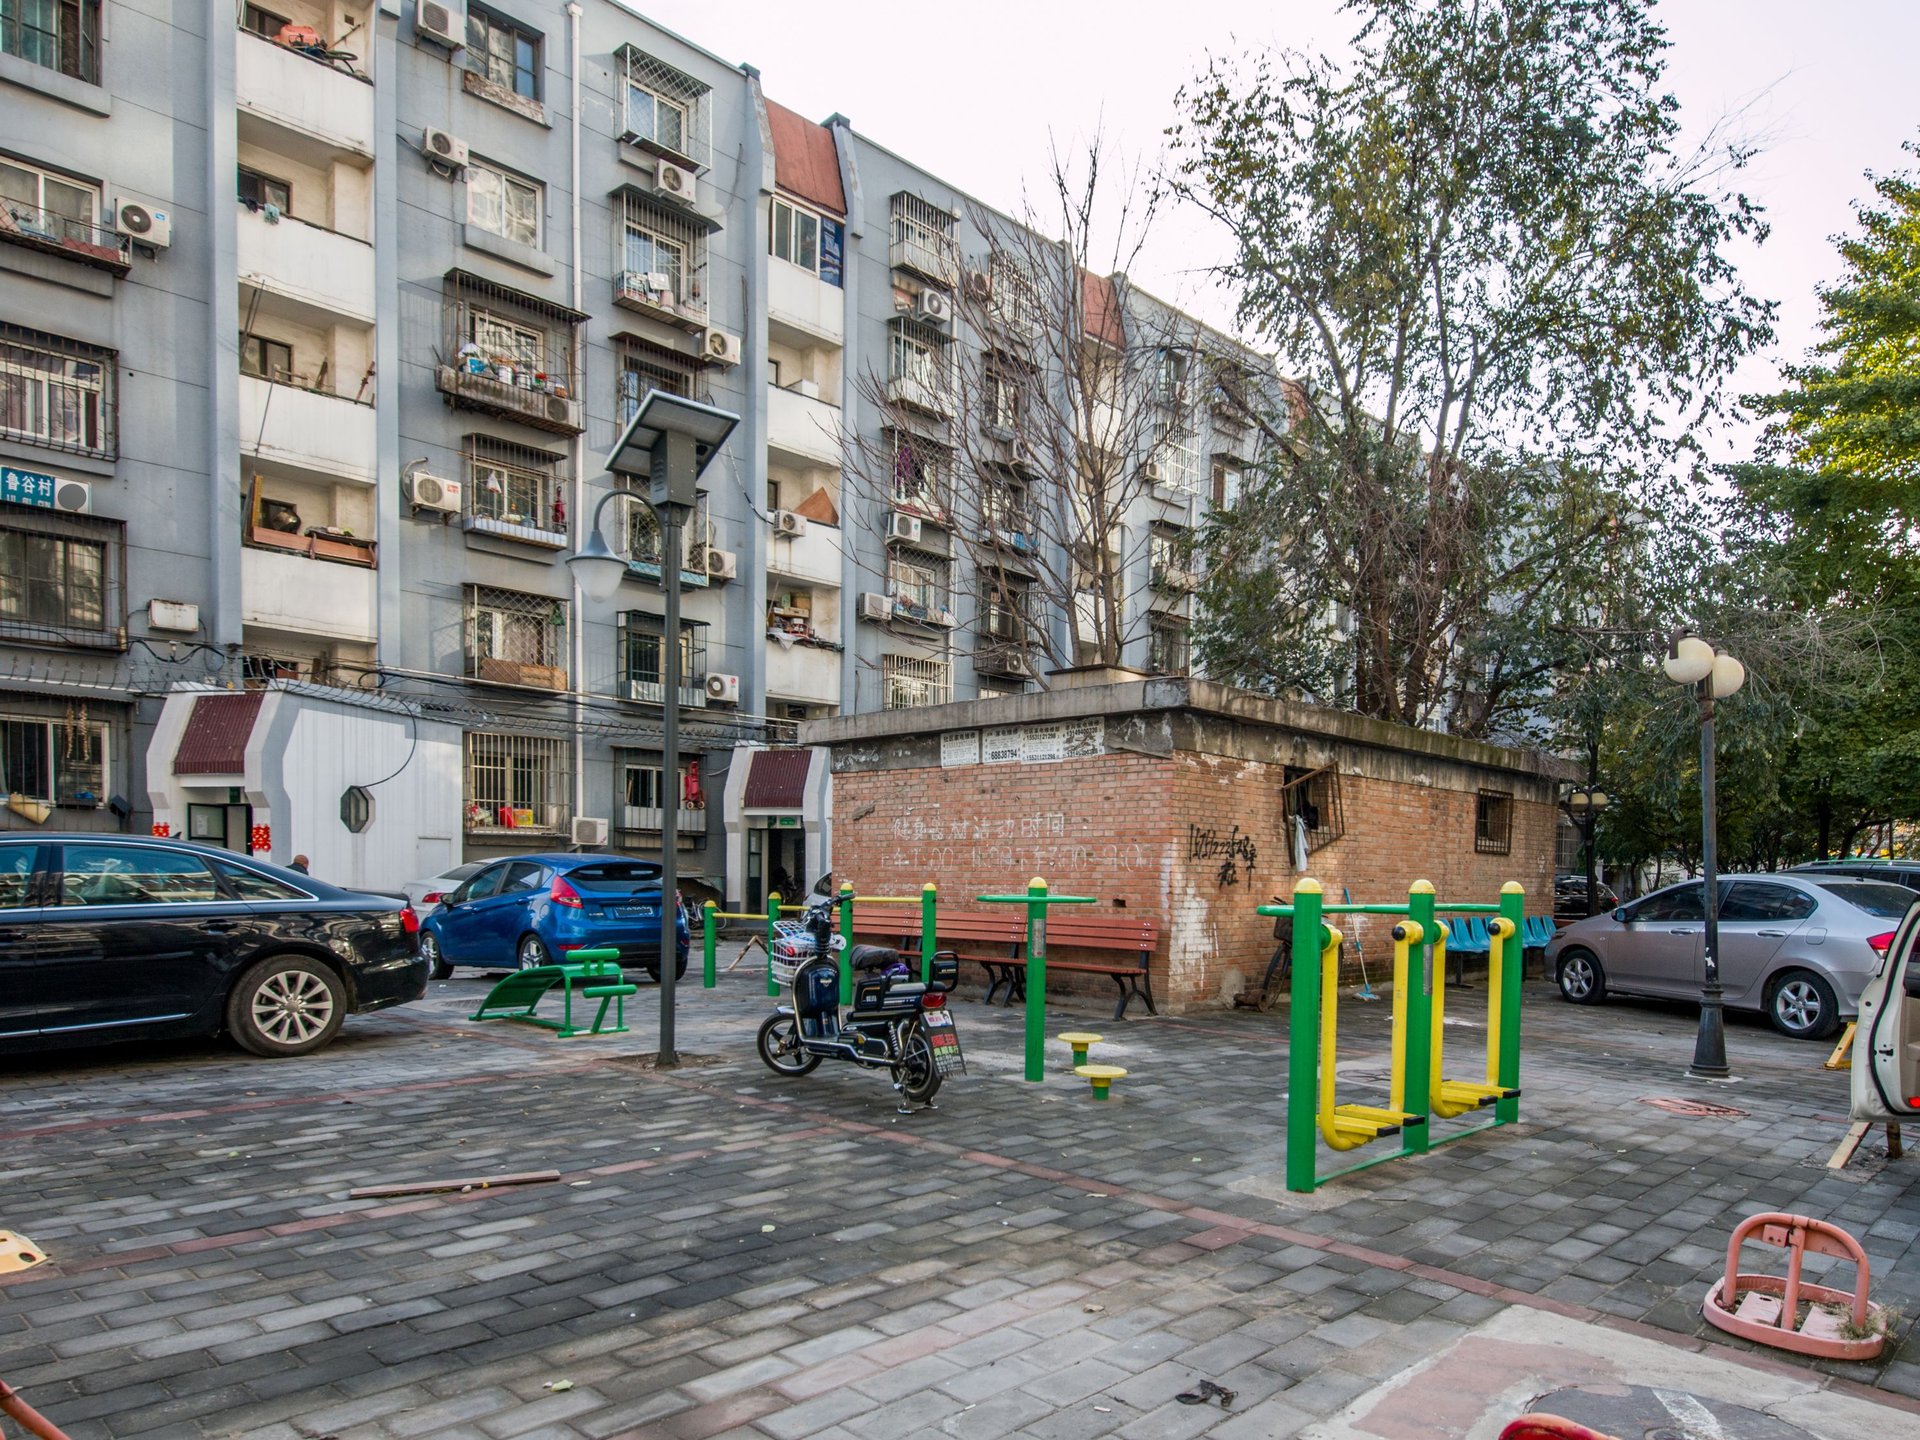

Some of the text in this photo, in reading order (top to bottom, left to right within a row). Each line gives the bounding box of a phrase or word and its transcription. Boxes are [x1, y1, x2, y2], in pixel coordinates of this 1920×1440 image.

[5, 472, 53, 497] 鲁谷村
[891, 812, 1065, 841] 健身器材活动时间
